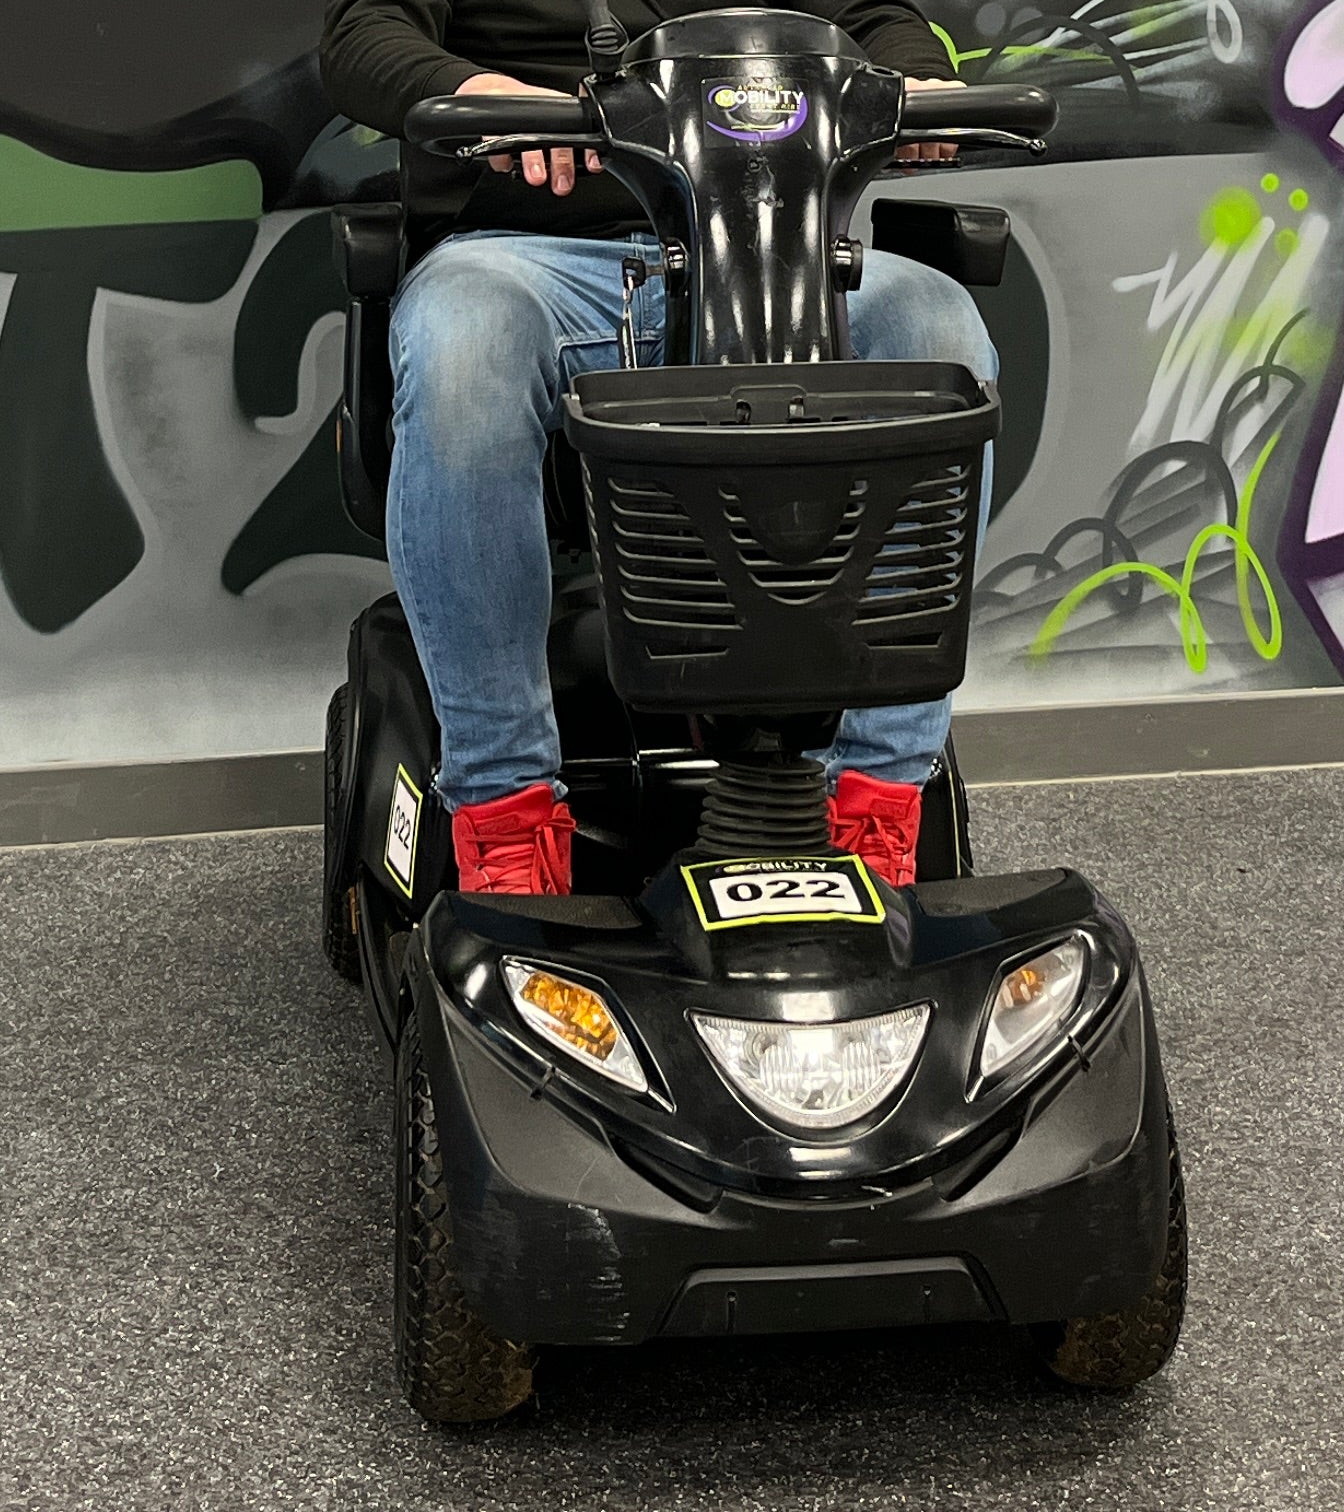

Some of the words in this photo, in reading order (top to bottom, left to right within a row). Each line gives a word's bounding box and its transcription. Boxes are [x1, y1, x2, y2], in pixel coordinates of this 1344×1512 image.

[720, 90, 804, 105] MOBILITY
[393, 804, 411, 850] 022
[726, 880, 845, 901] 022
